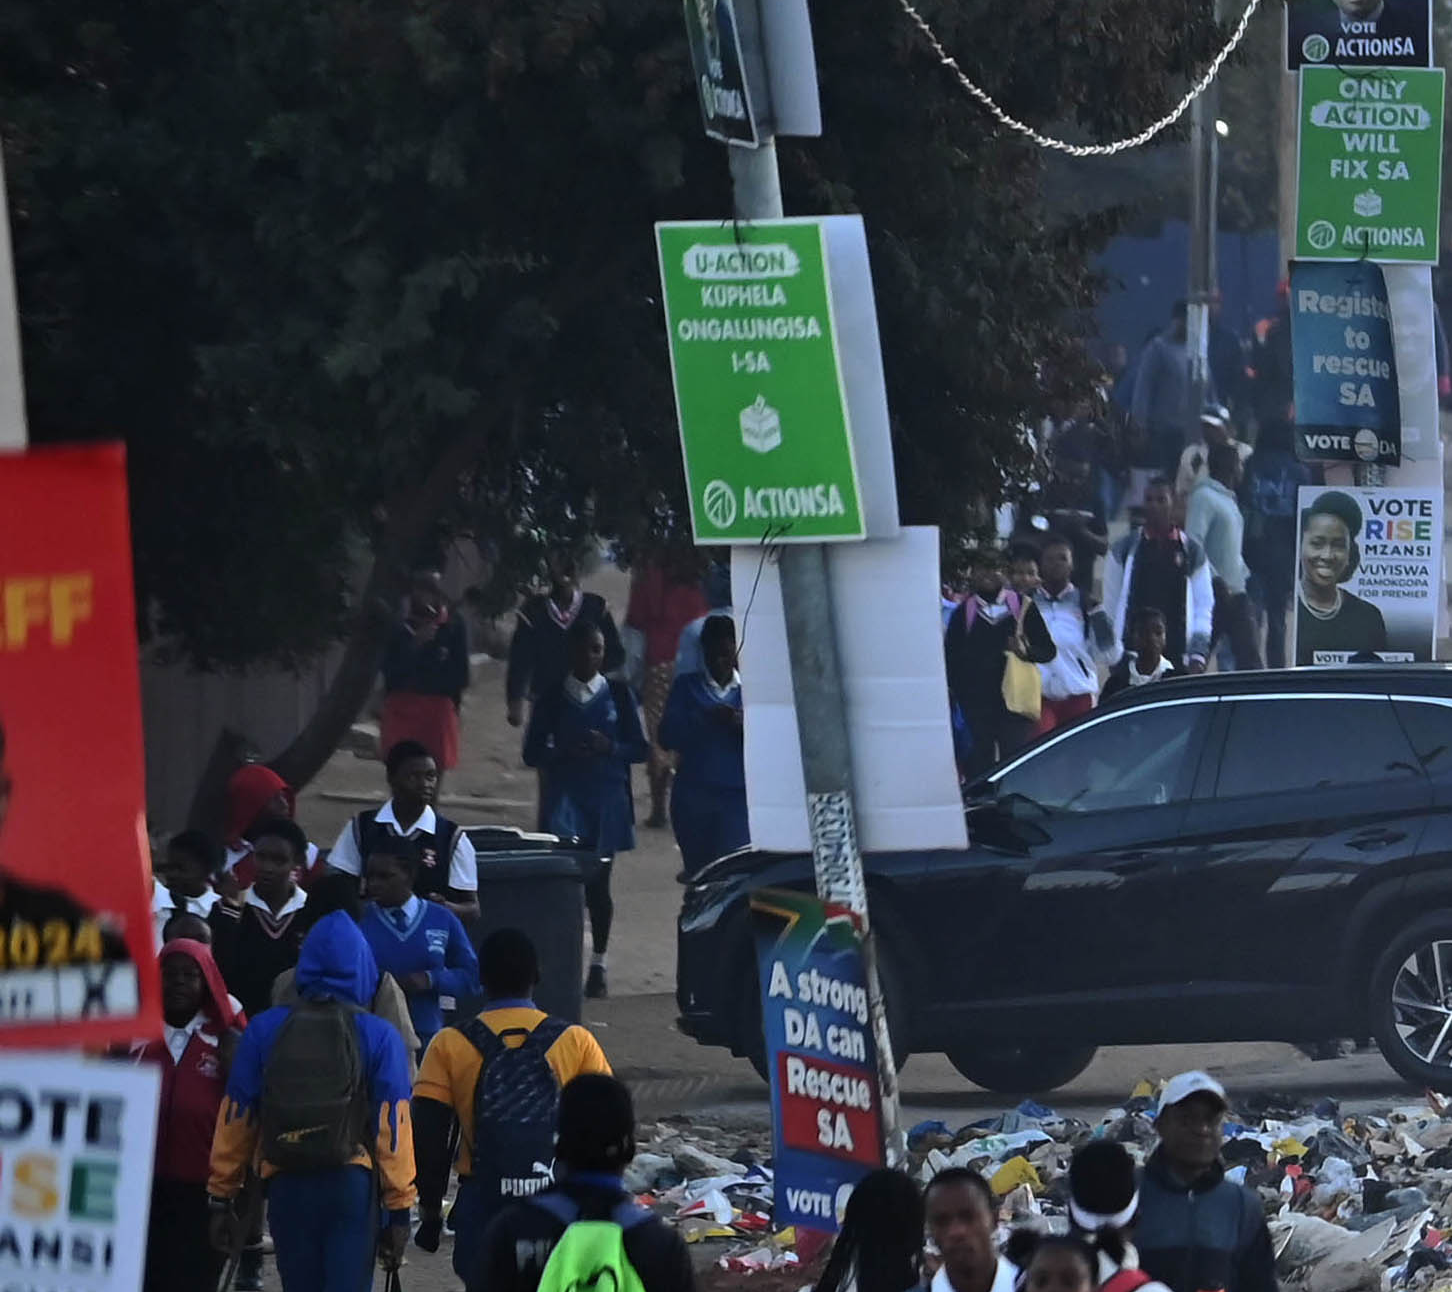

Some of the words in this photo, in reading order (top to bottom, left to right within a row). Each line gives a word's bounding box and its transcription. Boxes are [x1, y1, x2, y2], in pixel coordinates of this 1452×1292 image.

[1340, 22, 1377, 34] VOTE
[1335, 37, 1415, 56] ACTIONSA
[1339, 78, 1407, 100] ONLY
[1324, 106, 1420, 126] ACTION
[1342, 133, 1400, 153] WILL
[1330, 159, 1368, 179] FIX
[1377, 160, 1410, 181] SA
[1342, 225, 1425, 246] ACTIONSA
[696, 251, 786, 274] U-ACTION
[702, 285, 787, 307] KUPHELA
[678, 316, 822, 341] ONGALUNGISA
[1344, 326, 1370, 350] to
[1312, 355, 1390, 379] rescue
[1338, 382, 1375, 407] SA
[1304, 434, 1351, 450] VOTE
[744, 485, 845, 518] ACTIONSA
[1368, 499, 1432, 517] VOTE
[1365, 520, 1431, 541] RISE
[1364, 544, 1431, 557] MZANSI
[1359, 565, 1429, 576] VUYISWA
[1358, 590, 1379, 598] FOR
[1382, 590, 1428, 598] PREMIER
[768, 960, 793, 1000] A
[798, 968, 868, 1025] strong
[784, 1008, 822, 1050] DA
[826, 1024, 866, 1063] can
[786, 1057, 872, 1110] Rescue
[817, 1109, 854, 1152] SA
[501, 1176, 549, 1196] PUMA
[786, 1187, 831, 1218] VOTE
